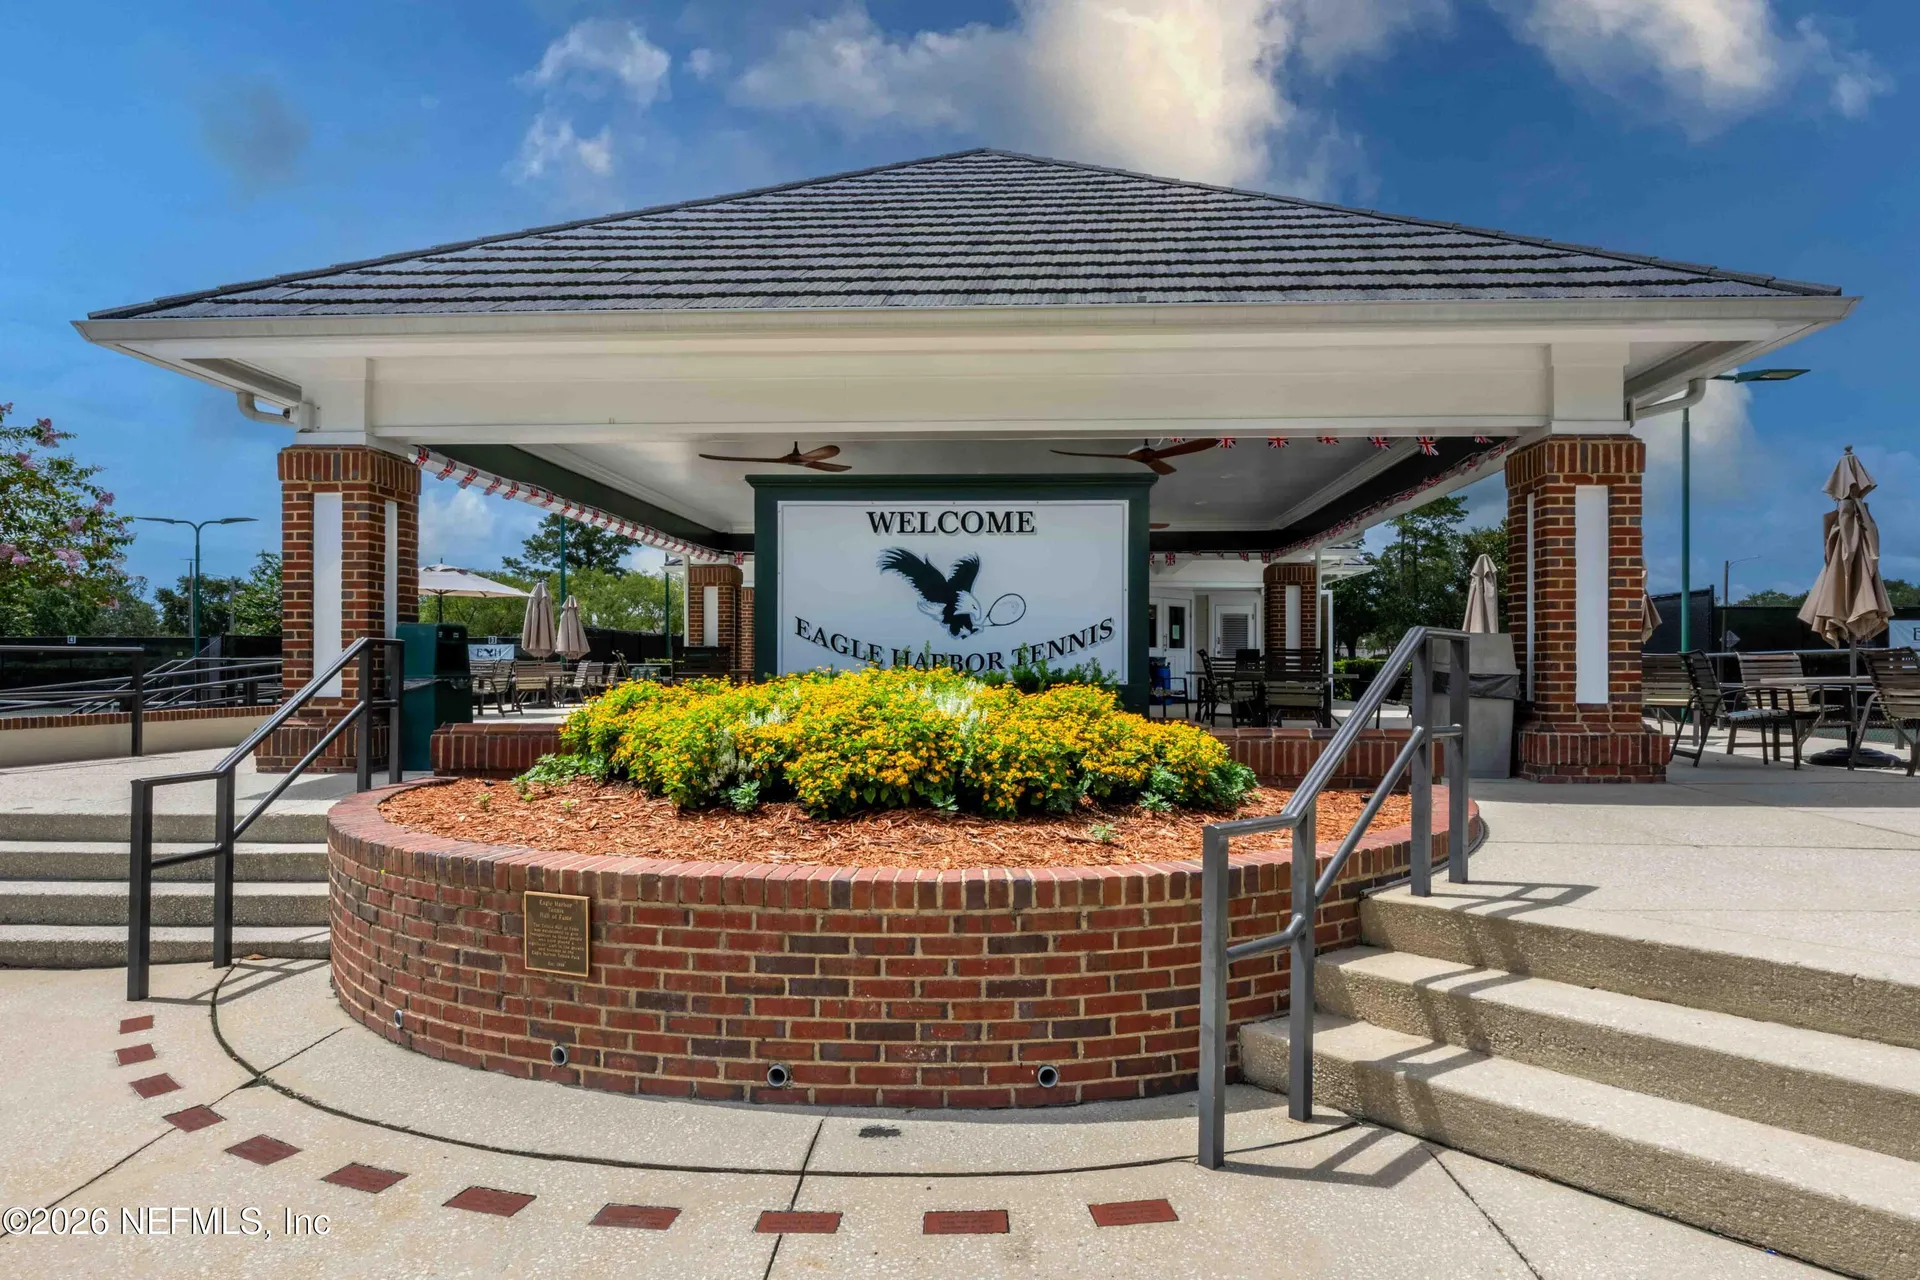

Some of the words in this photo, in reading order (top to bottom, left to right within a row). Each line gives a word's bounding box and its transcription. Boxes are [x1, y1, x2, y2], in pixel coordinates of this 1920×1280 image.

[866, 510, 1036, 534] WELCOME
[794, 616, 884, 665] EAGLE
[891, 648, 1005, 673] HARBOR
[1011, 617, 1114, 666] TENNIS
